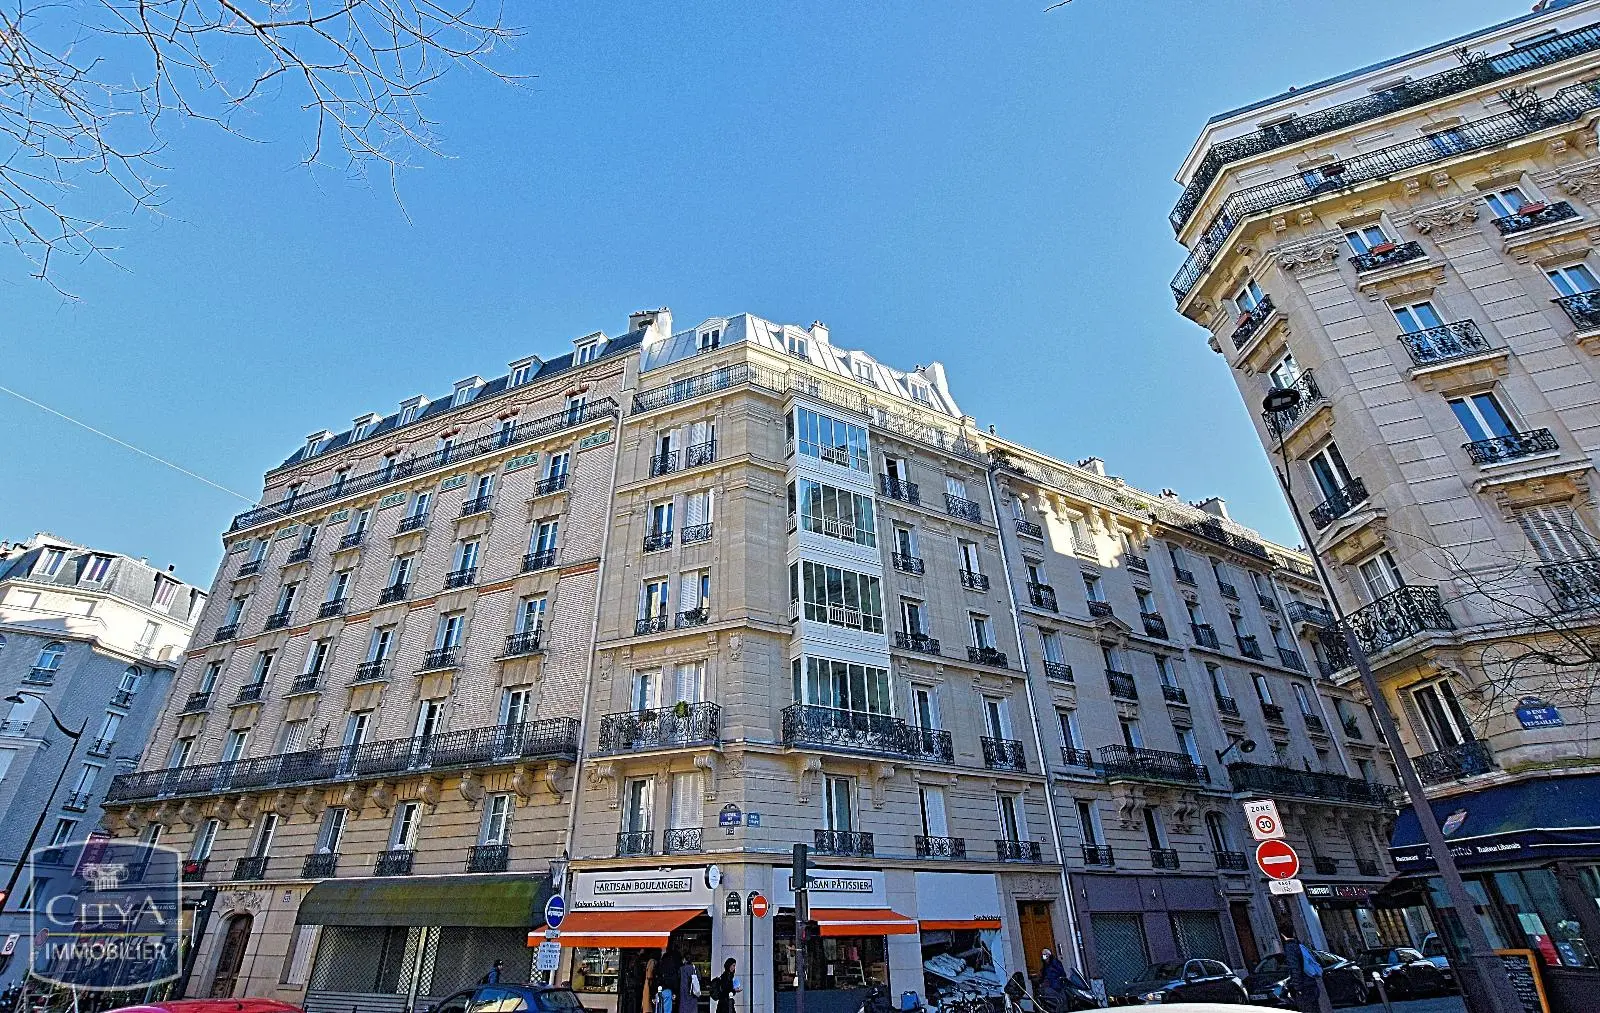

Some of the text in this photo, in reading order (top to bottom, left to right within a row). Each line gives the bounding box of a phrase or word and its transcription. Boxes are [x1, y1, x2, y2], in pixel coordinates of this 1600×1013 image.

[1251, 805, 1271, 813] ZONE
[1259, 820, 1272, 829] 30
[599, 880, 684, 892] ARTISAN BOULANGER
